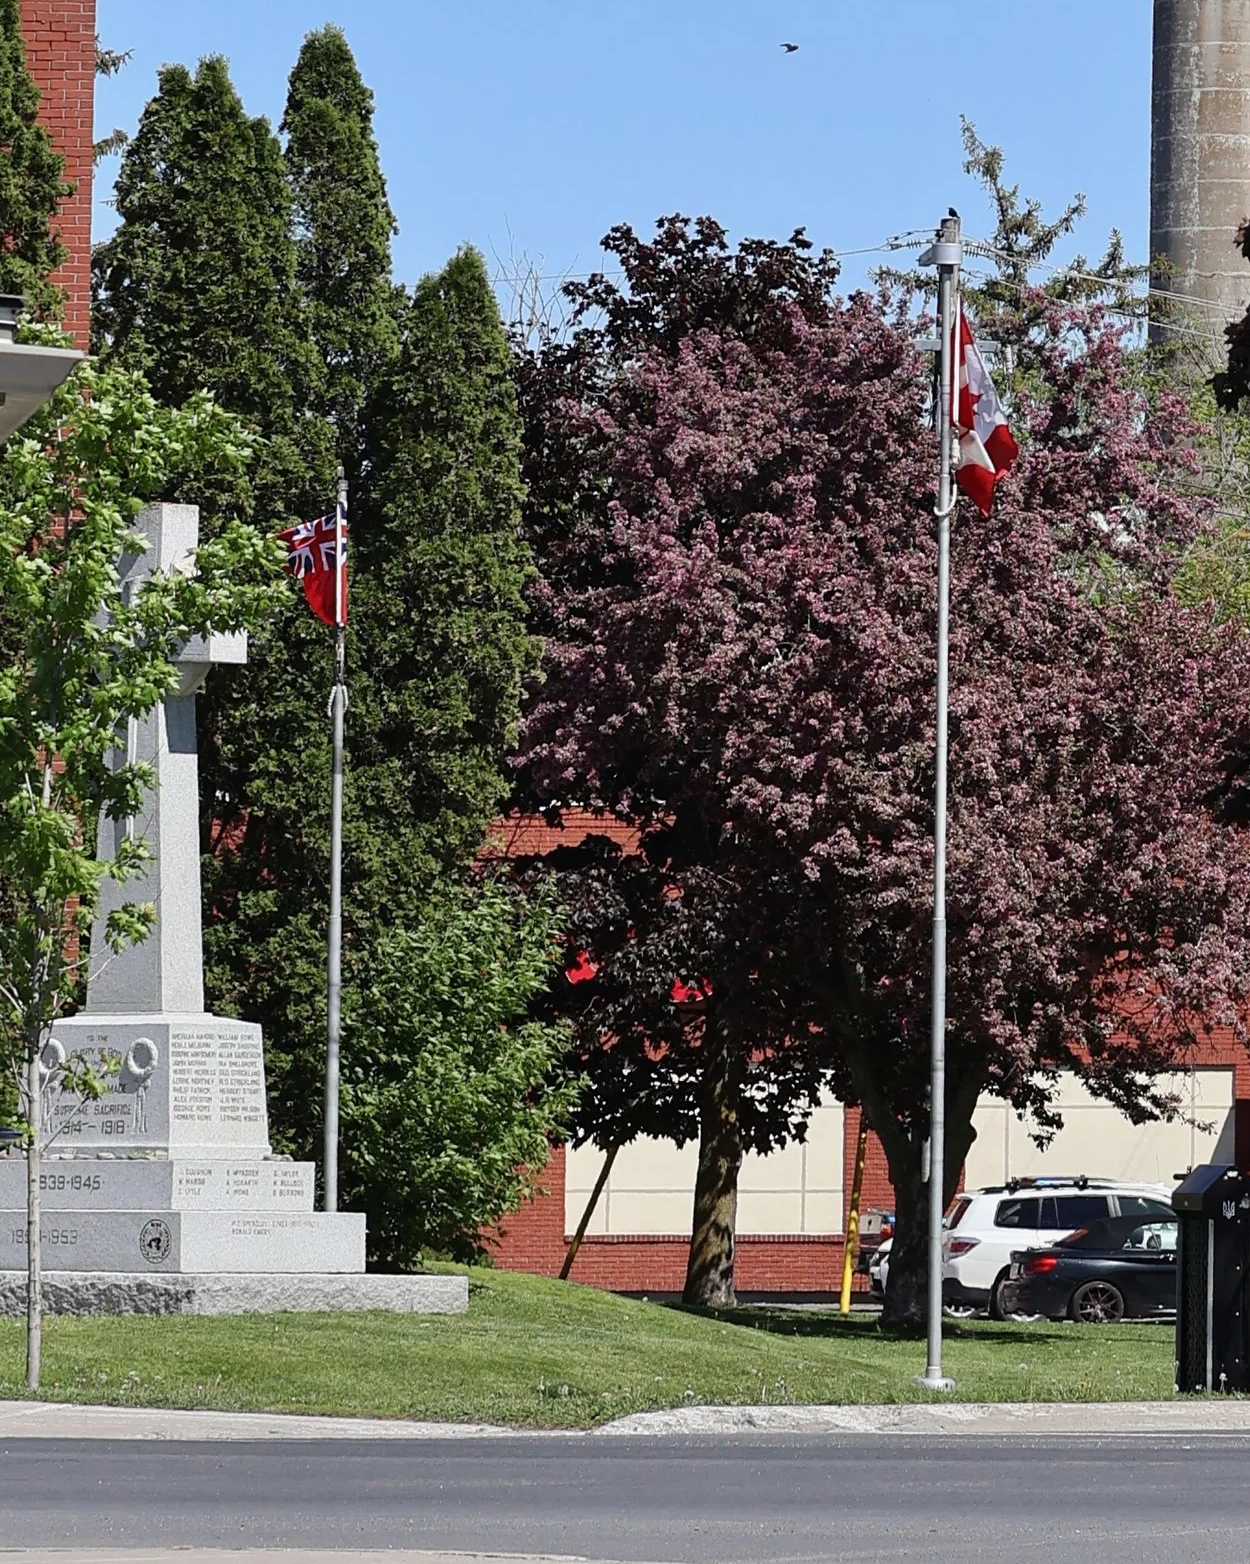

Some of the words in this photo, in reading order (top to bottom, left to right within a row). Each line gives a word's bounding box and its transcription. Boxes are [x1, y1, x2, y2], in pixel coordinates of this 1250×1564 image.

[108, 1047, 122, 1056] GOD
[107, 1083, 128, 1093] MADE
[94, 1104, 131, 1115] SACRIFICE
[102, 1120, 125, 1134] 1918
[39, 1175, 101, 1190] 939-1945
[12, 1229, 78, 1244] 195-1953
